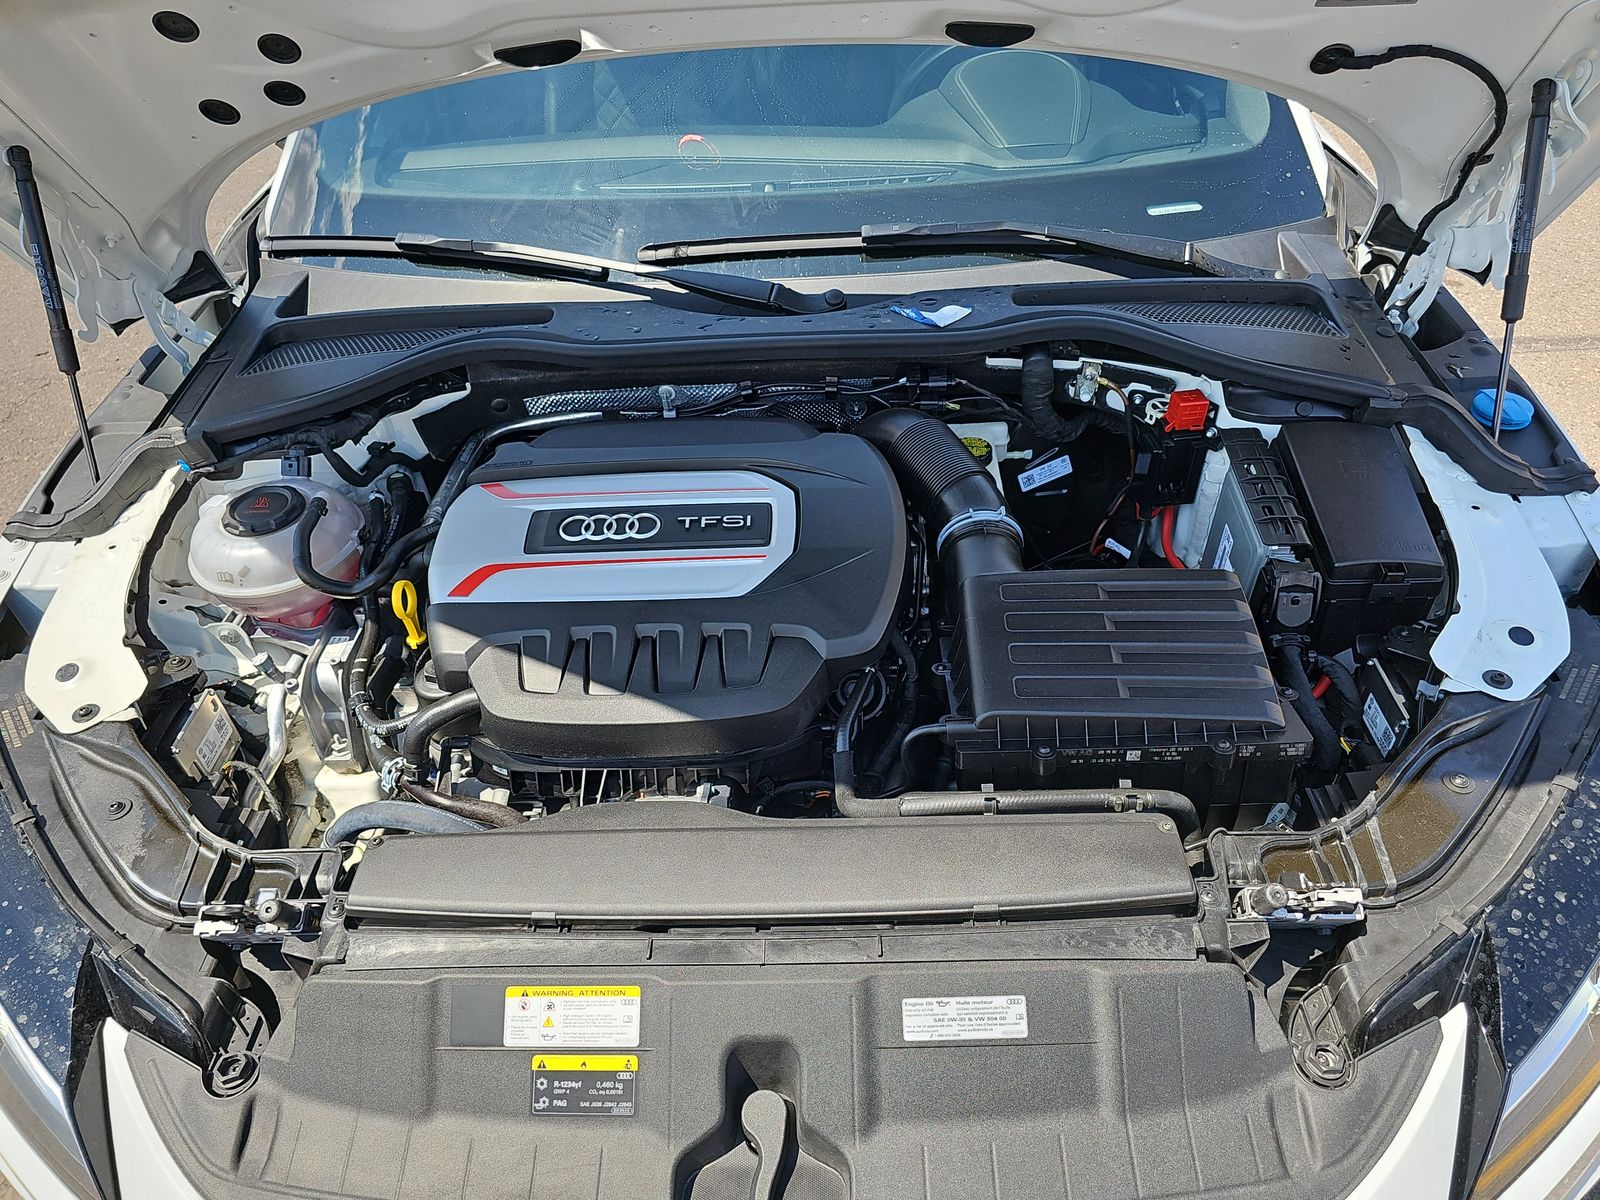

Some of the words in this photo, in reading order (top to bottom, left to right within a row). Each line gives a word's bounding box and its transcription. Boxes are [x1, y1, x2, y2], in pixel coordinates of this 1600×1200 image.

[677, 515, 752, 529] TFSI
[554, 1080, 582, 1089] R-1234yf
[615, 1081, 624, 1090] kg
